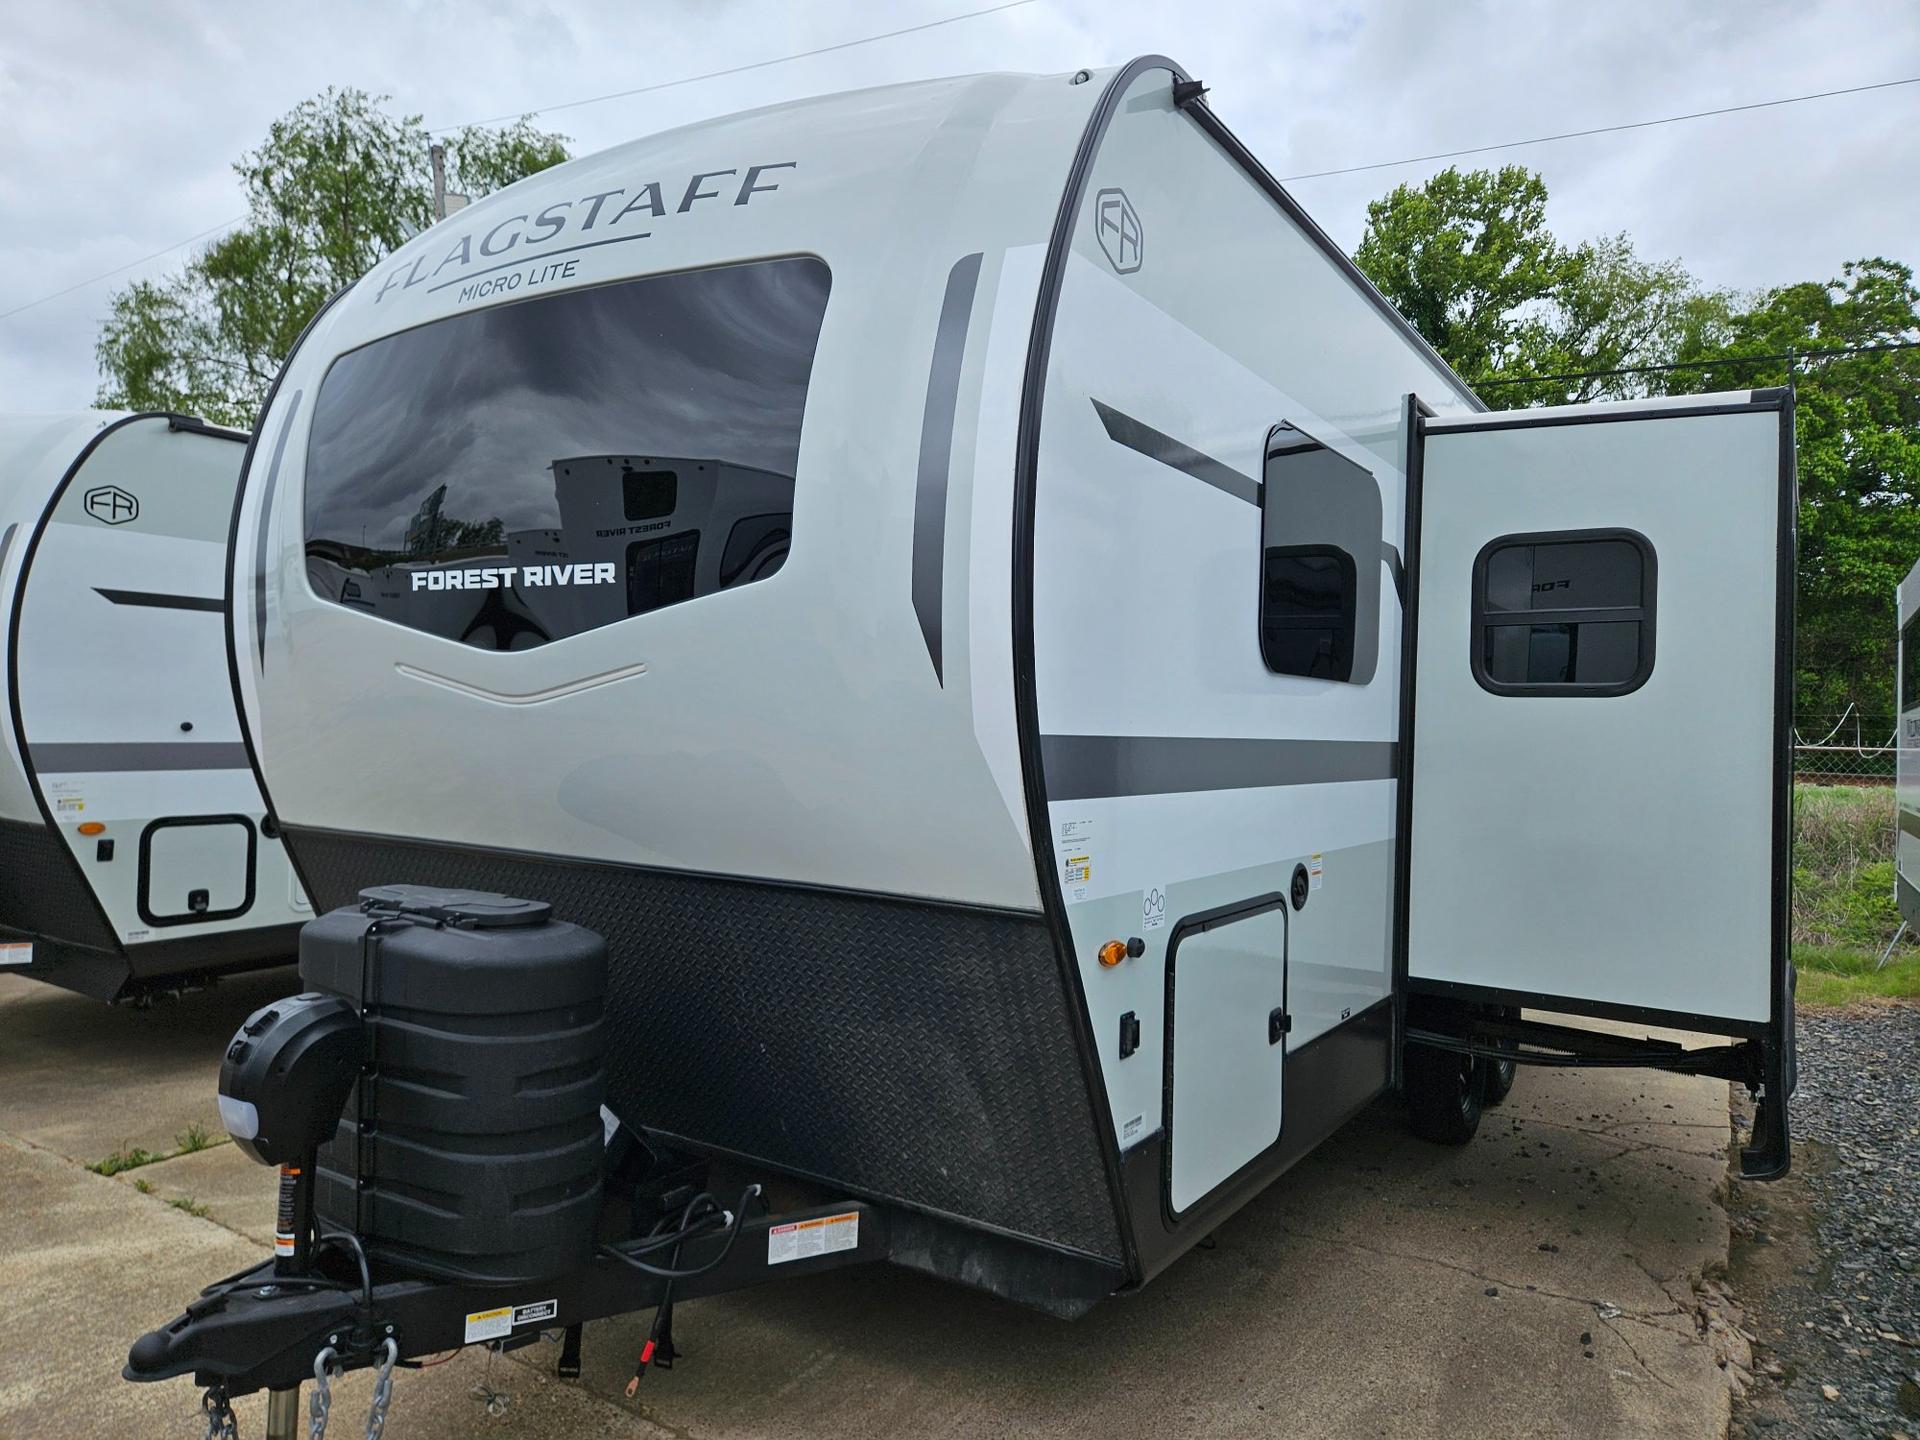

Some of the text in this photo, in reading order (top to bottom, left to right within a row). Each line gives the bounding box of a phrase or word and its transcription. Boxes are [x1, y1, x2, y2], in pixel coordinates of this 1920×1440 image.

[375, 161, 797, 304] FLAGSTAFF
[458, 259, 580, 303] MICRO LITE
[411, 562, 616, 592] FOREST RIVER
